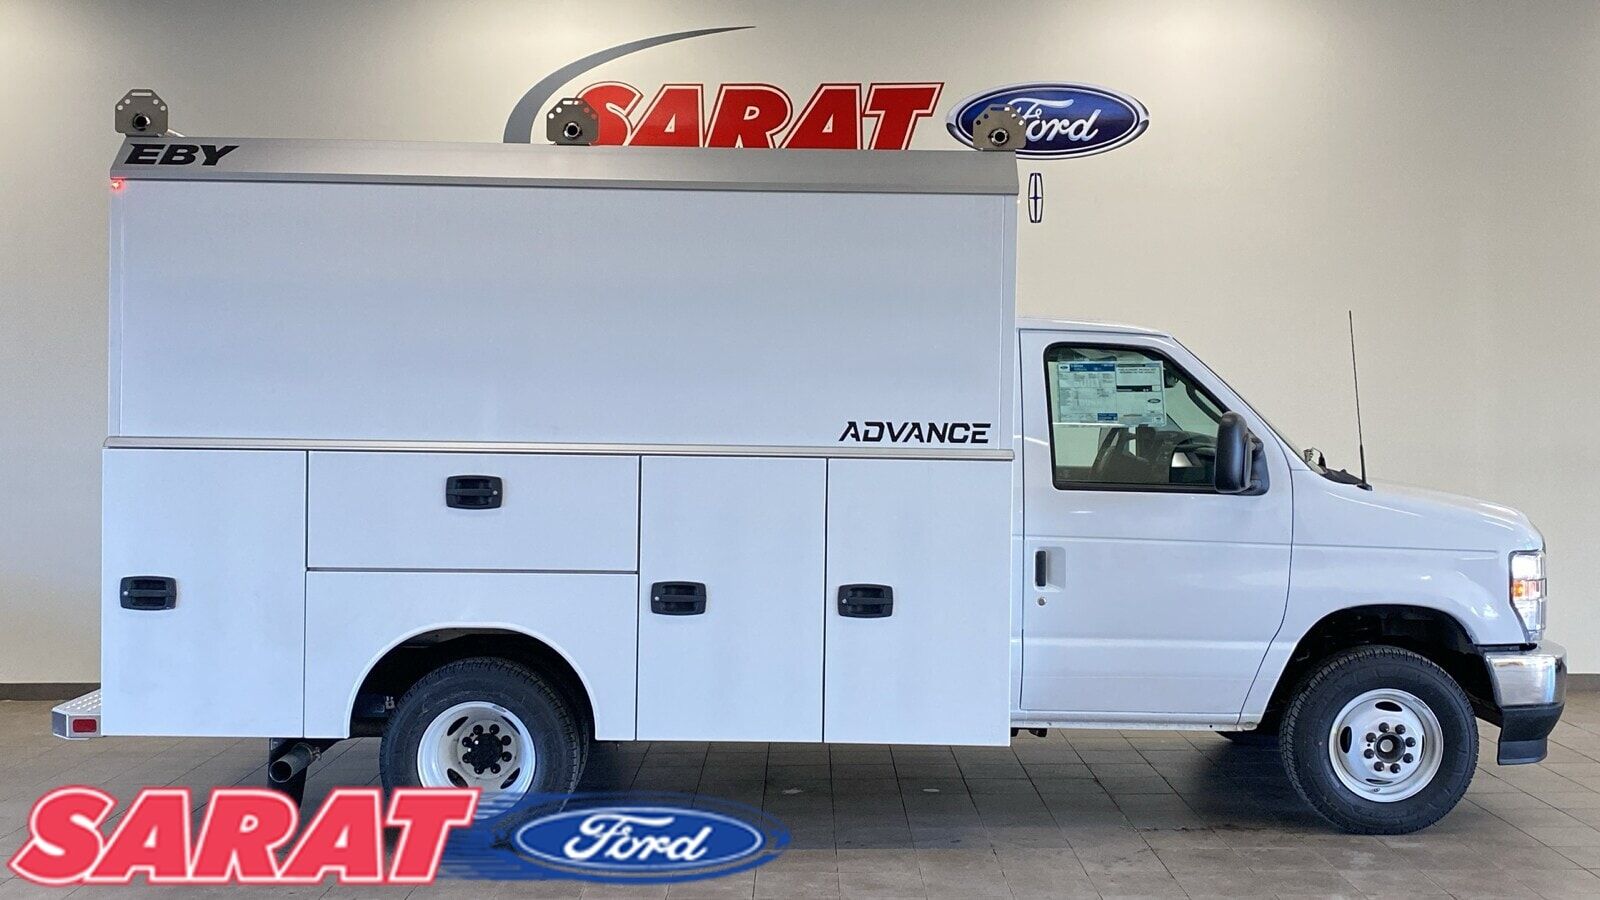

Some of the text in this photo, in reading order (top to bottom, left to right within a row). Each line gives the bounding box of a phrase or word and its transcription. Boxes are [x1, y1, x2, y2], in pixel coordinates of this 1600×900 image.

[576, 81, 944, 149] SARAT
[124, 143, 240, 166] EBY
[838, 421, 991, 444] ADVANCE
